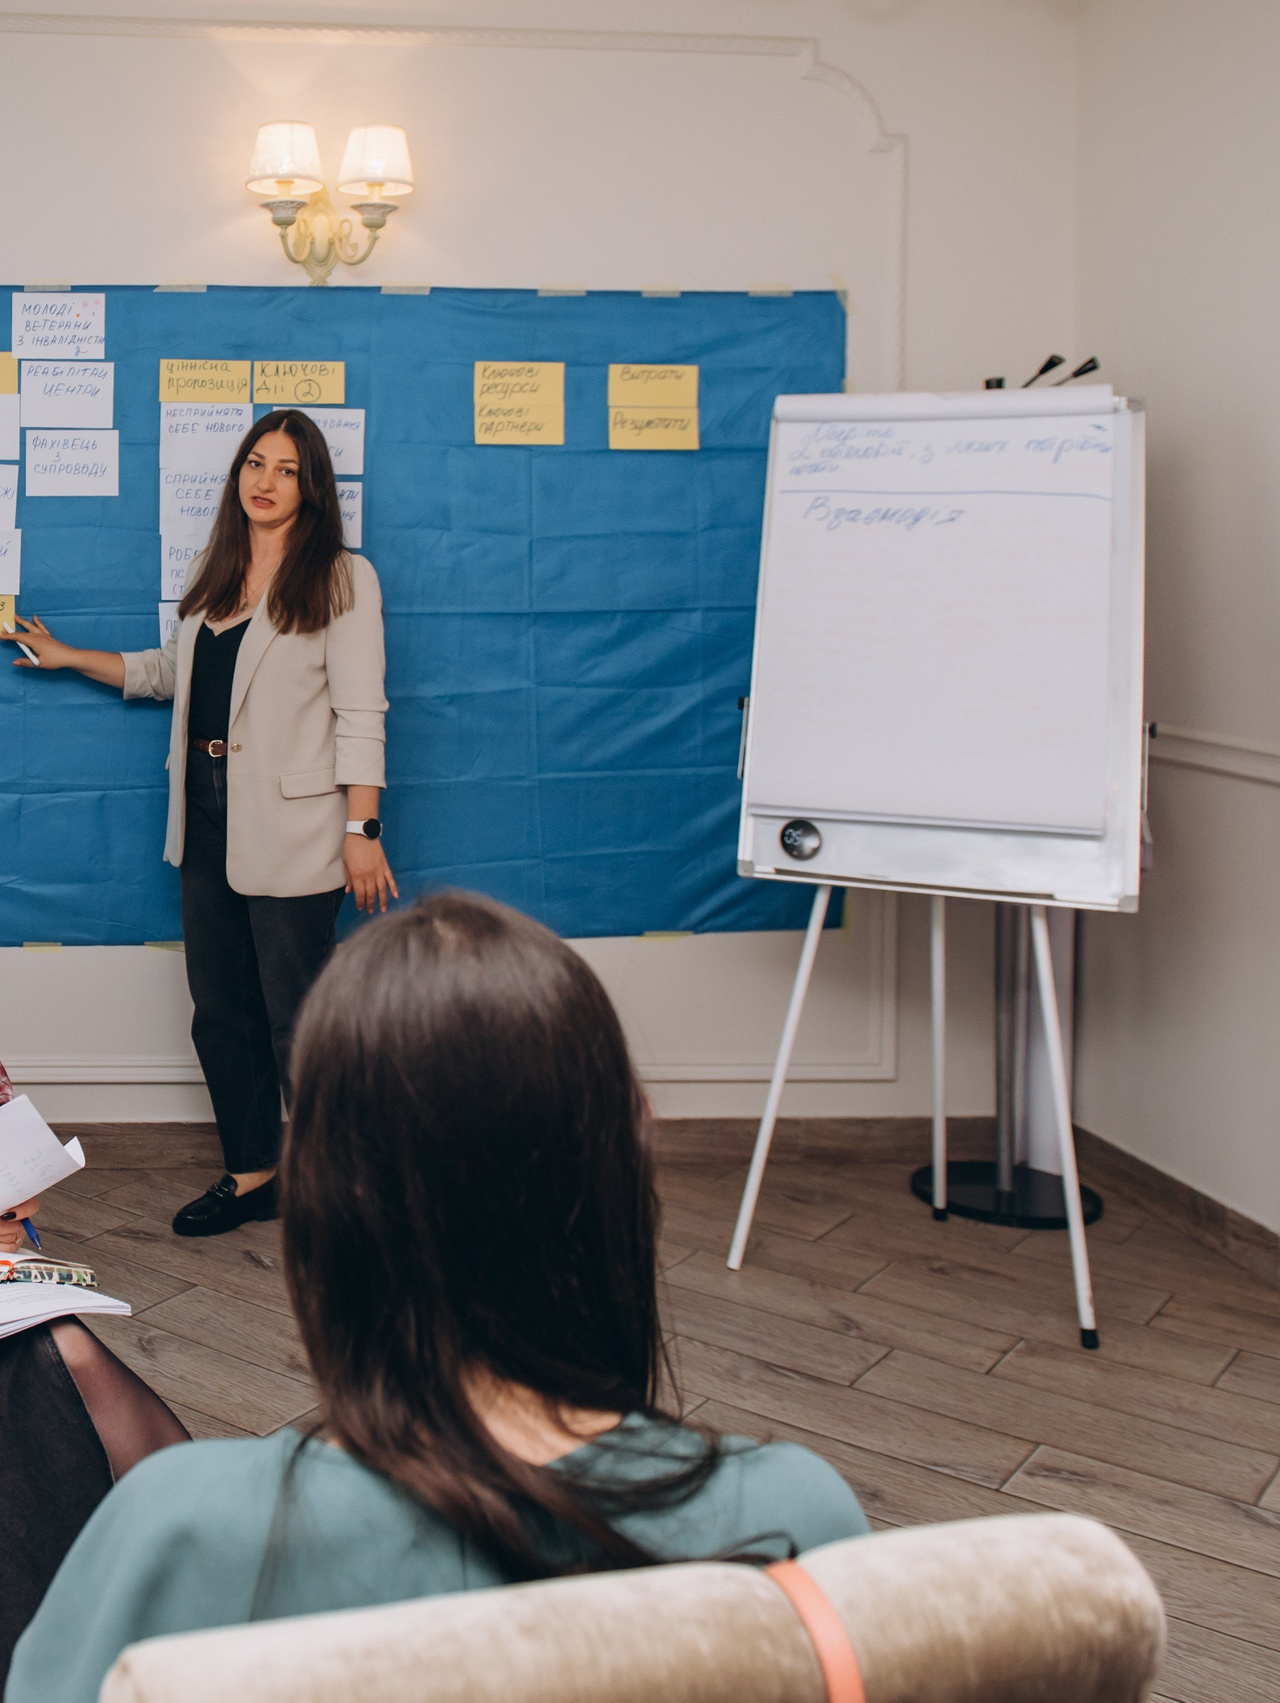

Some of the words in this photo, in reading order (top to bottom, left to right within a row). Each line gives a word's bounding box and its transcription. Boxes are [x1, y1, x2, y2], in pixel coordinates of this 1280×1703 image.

[21, 302, 73, 317] МОЛОДІ
[24, 319, 92, 332] ВЕТЕРАНИ
[43, 383, 101, 398] ЦЕНТРИ
[168, 422, 200, 434] СЕБЕ
[32, 435, 98, 451] ФАХІВЕЦЬ
[33, 463, 107, 478] СУПРОВОДУ
[175, 489, 215, 500] СЕБЕ
